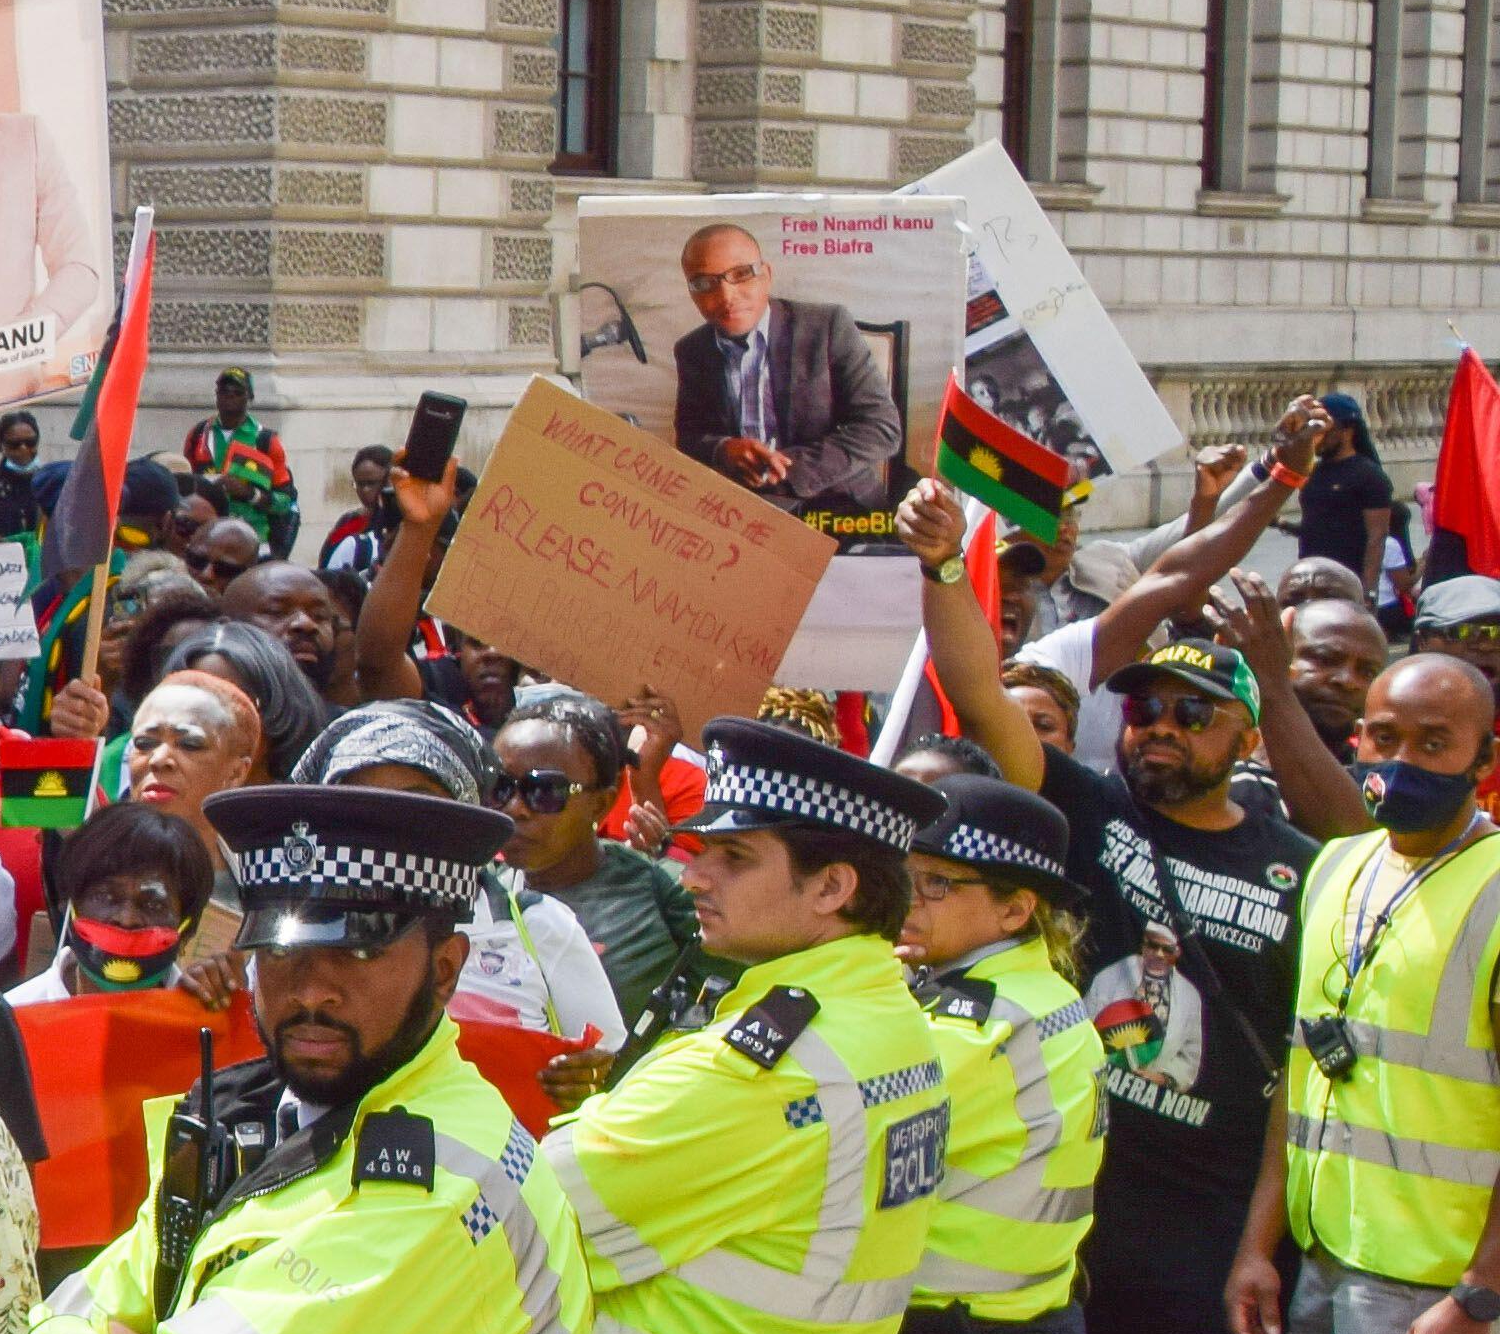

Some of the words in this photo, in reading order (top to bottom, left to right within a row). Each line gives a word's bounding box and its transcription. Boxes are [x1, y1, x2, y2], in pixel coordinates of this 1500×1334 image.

[781, 217, 818, 234] Free
[823, 214, 888, 233] Nnamdi
[892, 213, 935, 231] kanu
[781, 239, 818, 256] Free
[824, 238, 874, 255] Biafra
[9, 353, 22, 365] of
[21, 347, 46, 363] Biafra
[541, 410, 617, 465] WHAT
[612, 445, 692, 498] CRIME
[695, 489, 744, 530] HAS
[479, 483, 612, 589] RELEASE
[1237, 899, 1290, 943] KANU
[1158, 1089, 1212, 1127] NOW
[365, 1160, 423, 1178] 4608
